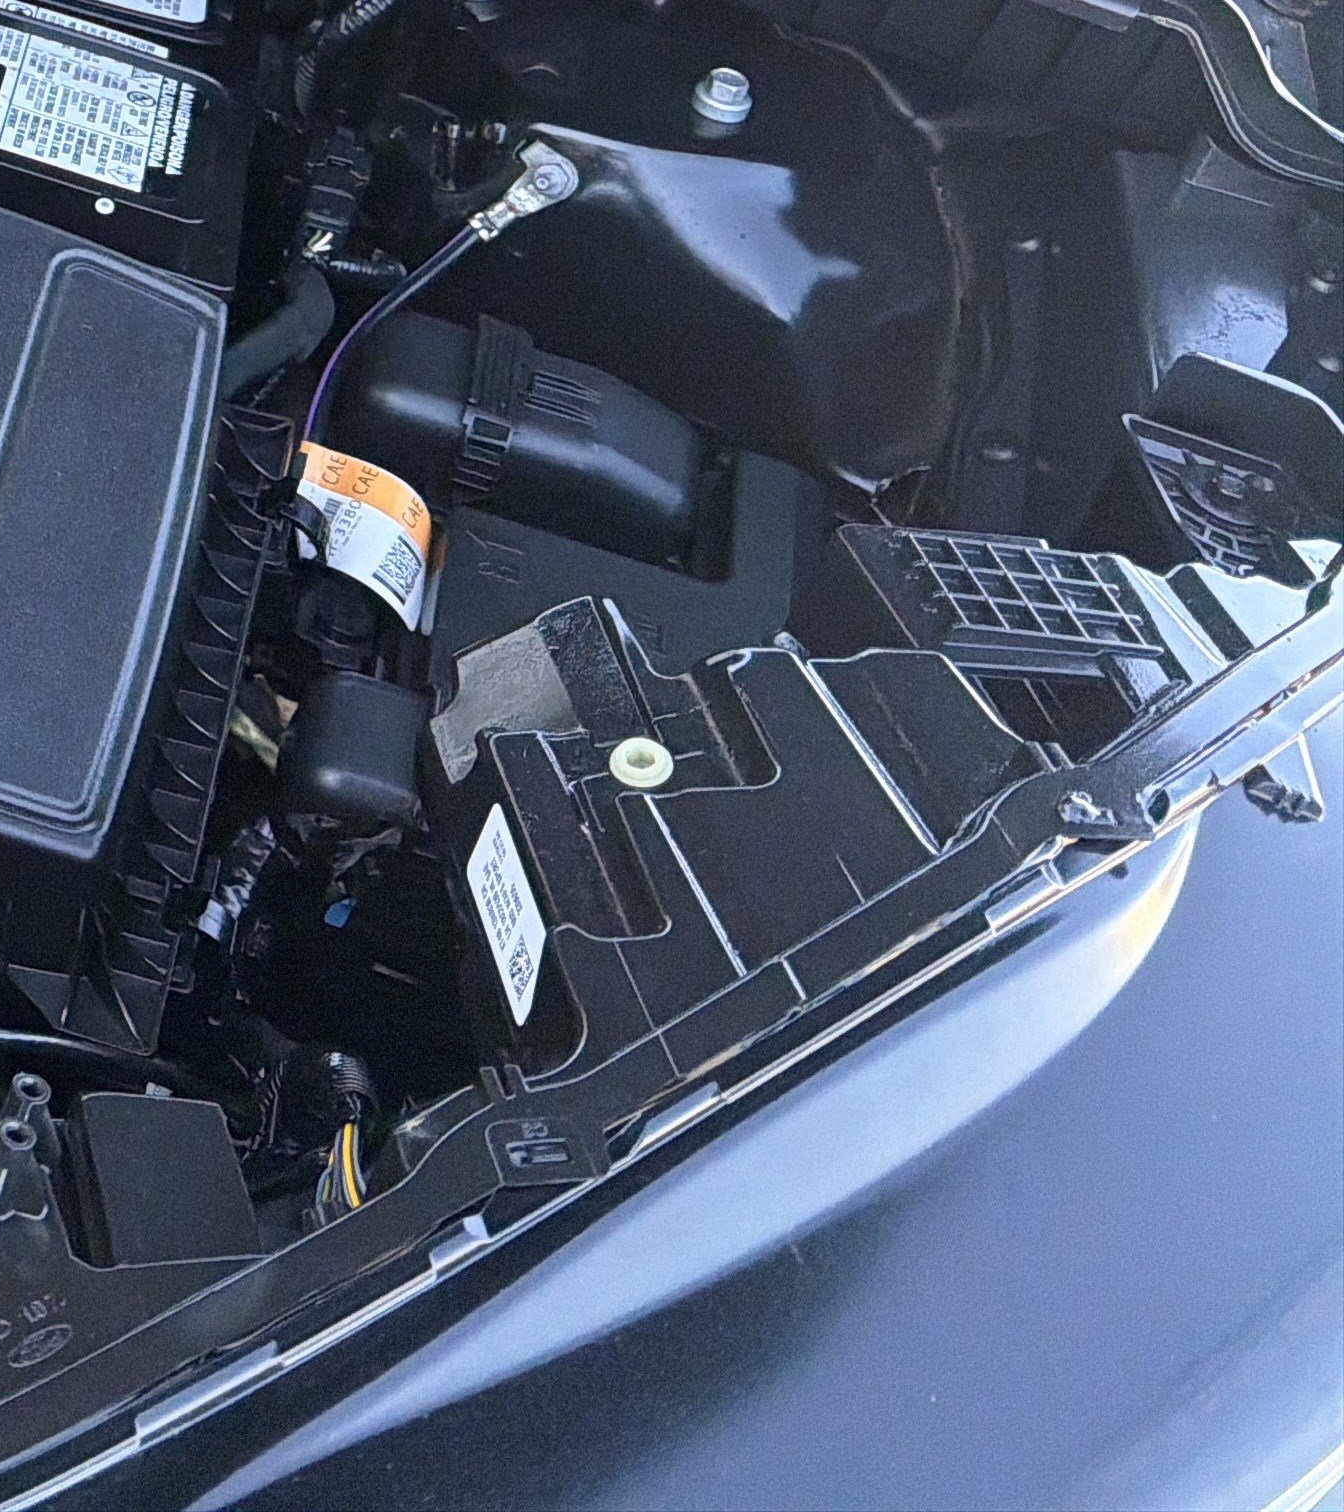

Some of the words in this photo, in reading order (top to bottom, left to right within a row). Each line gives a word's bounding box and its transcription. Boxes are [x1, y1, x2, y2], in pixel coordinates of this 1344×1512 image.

[321, 454, 348, 486] CAE
[352, 465, 380, 495] CAE
[401, 496, 424, 529] CAE
